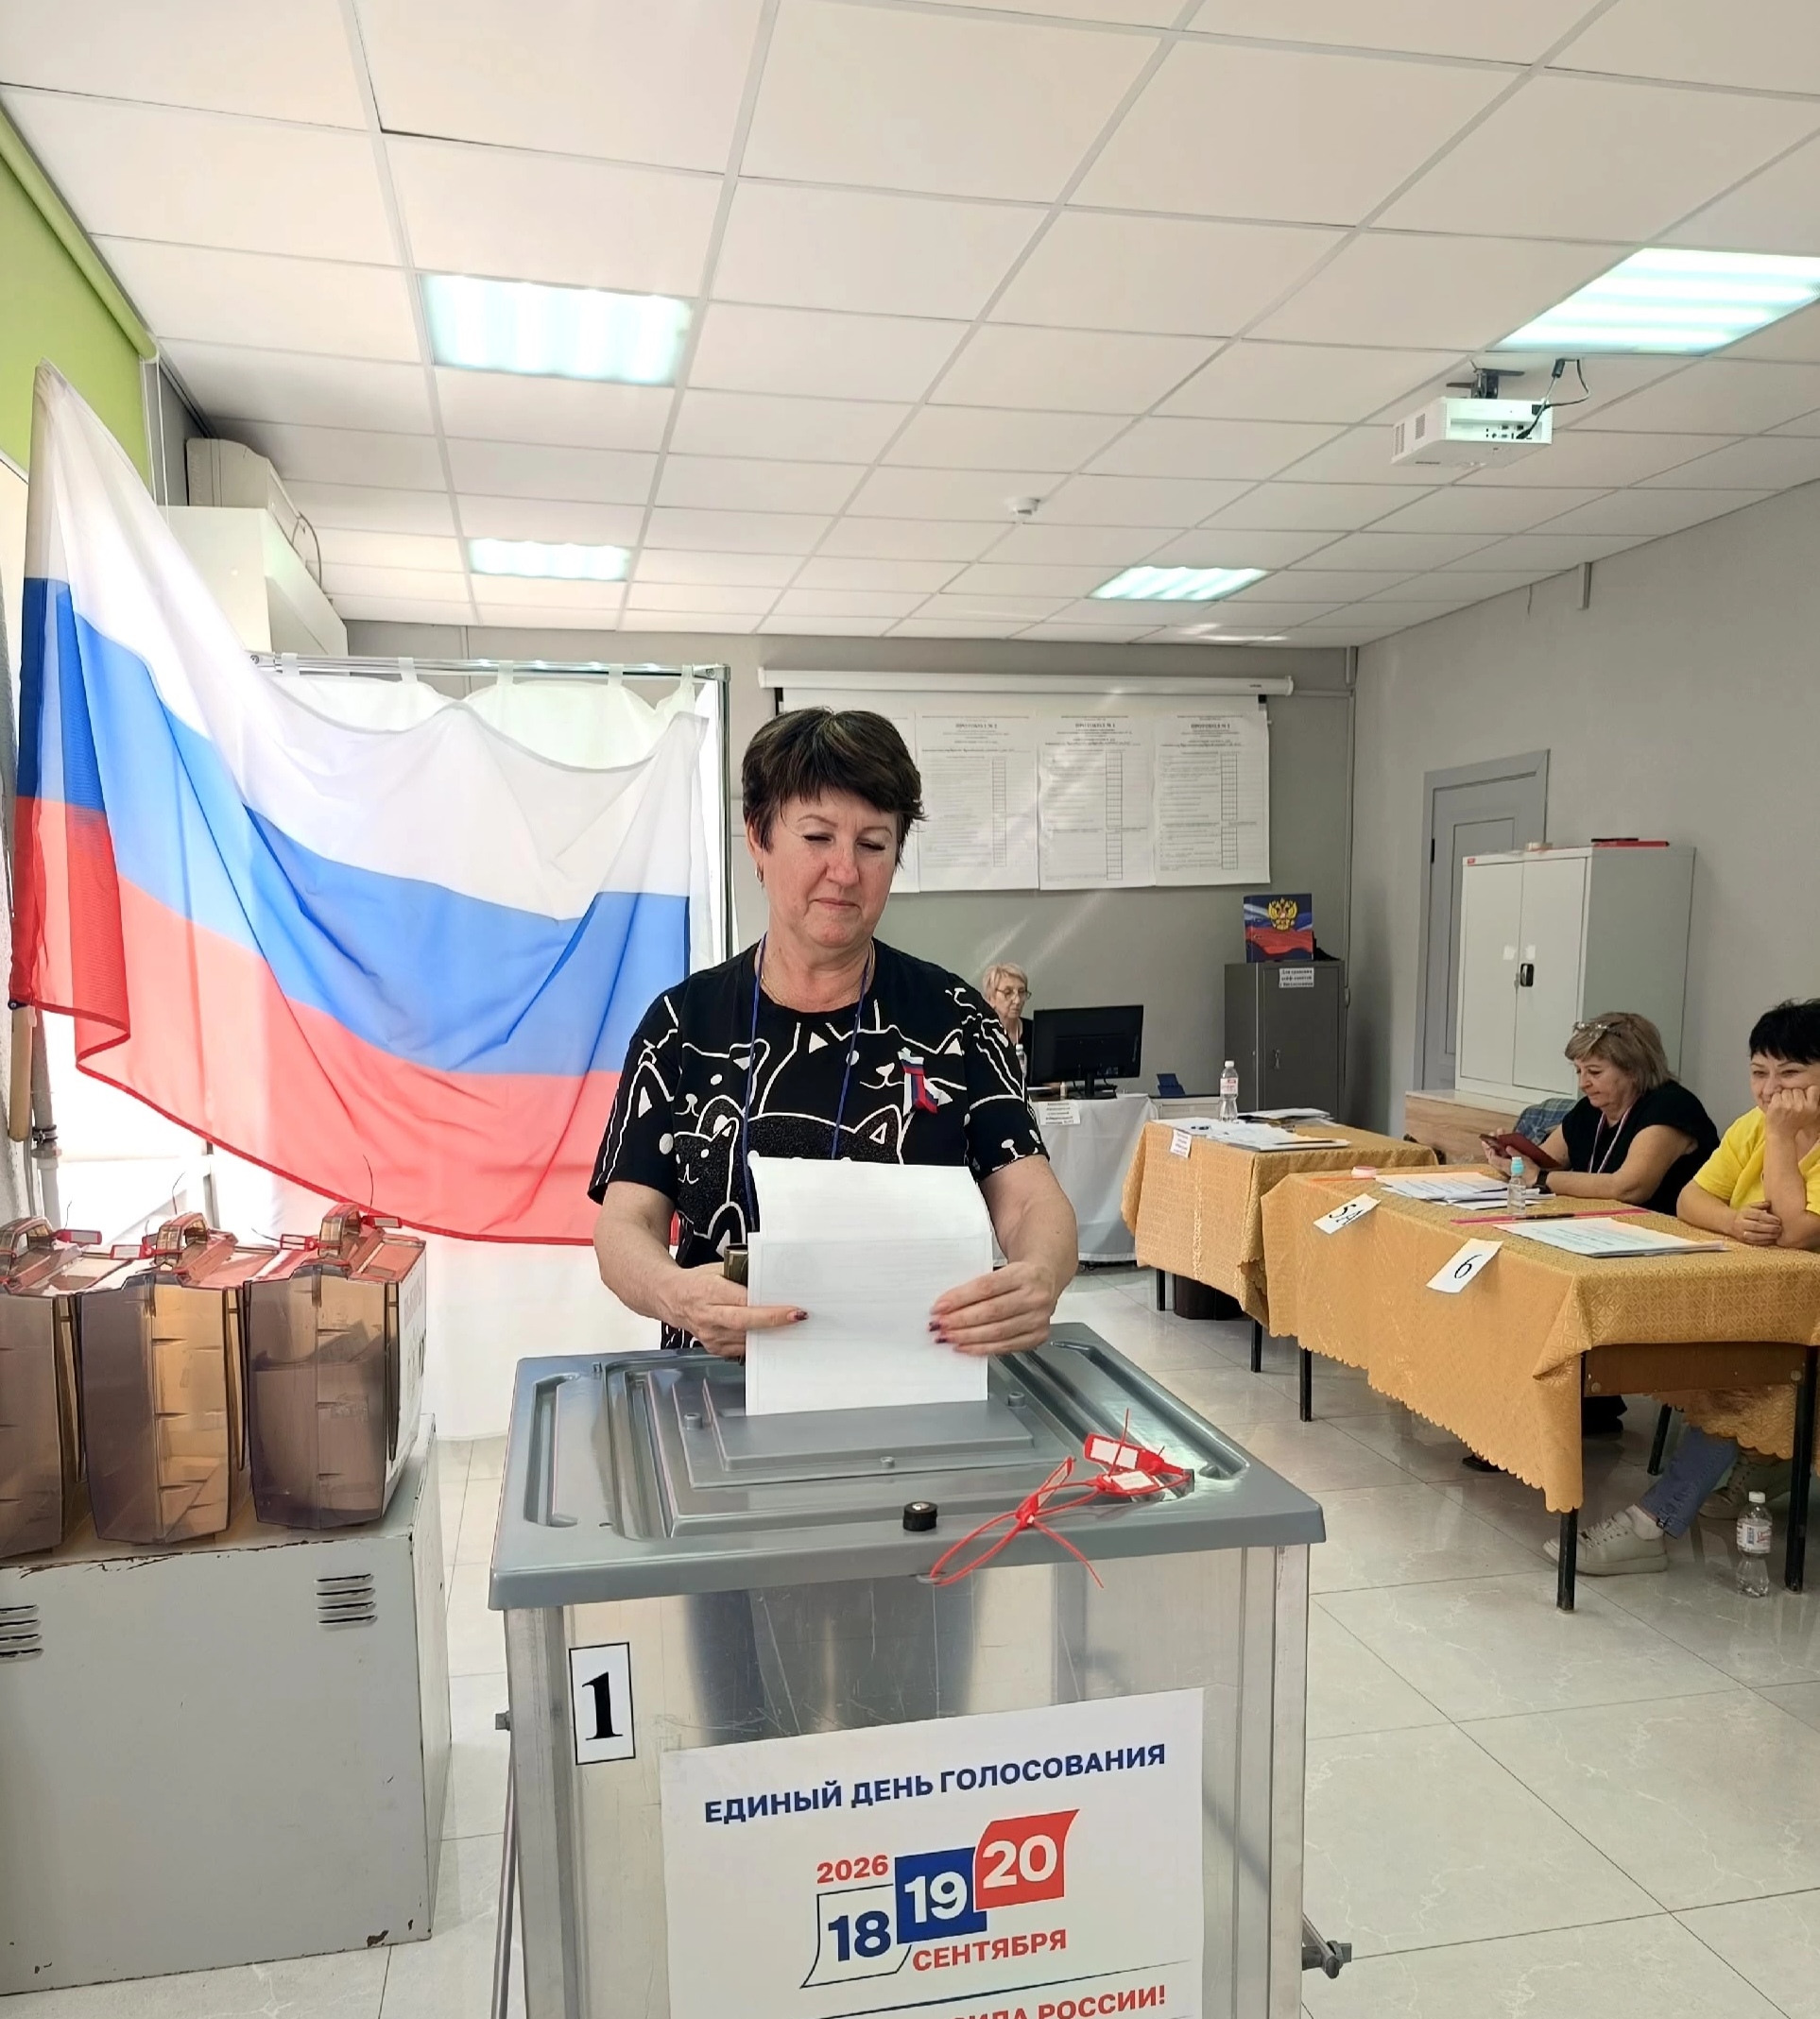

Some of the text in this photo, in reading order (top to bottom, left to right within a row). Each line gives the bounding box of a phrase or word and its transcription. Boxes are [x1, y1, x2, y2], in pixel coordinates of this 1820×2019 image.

[1454, 1254, 1483, 1279] 6
[582, 1672, 623, 1740] 1
[705, 1744, 1165, 1824] ЕДИНЫЙ ДЕНЬ ГОЛОСОВАНИЯ
[817, 1854, 888, 1884] 2026
[982, 1834, 1058, 1890] 20
[903, 1872, 968, 1924] 19
[828, 1910, 891, 1962] 18
[913, 1929, 1067, 1971] СЕНТЯБРЯ
[1038, 1986, 1164, 2019] РОССИИ!
